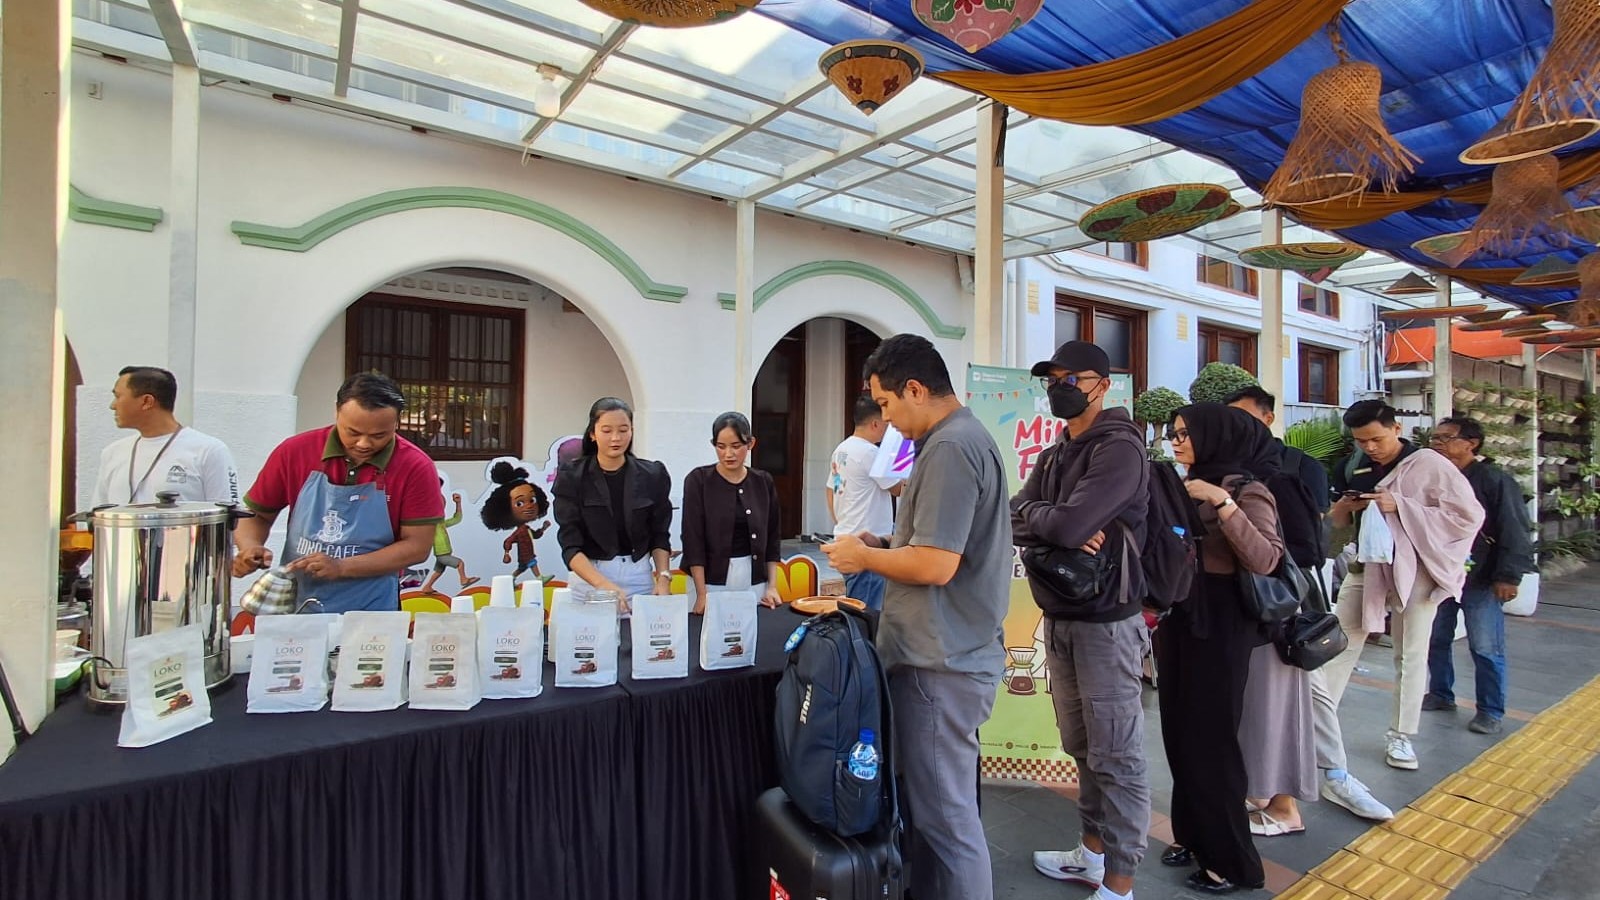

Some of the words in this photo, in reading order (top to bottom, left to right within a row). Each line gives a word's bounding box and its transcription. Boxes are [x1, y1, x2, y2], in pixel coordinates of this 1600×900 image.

[296, 536, 322, 556] LOKO
[326, 544, 360, 559] CAFE
[650, 622, 671, 631] LOKO
[496, 637, 520, 646] LOKO
[575, 634, 596, 642] LOKO
[275, 645, 304, 656] LOKO
[360, 643, 385, 651] LOKO
[431, 644, 456, 653] LOKO
[153, 662, 182, 678] LOKO
[800, 683, 812, 724] THULE
